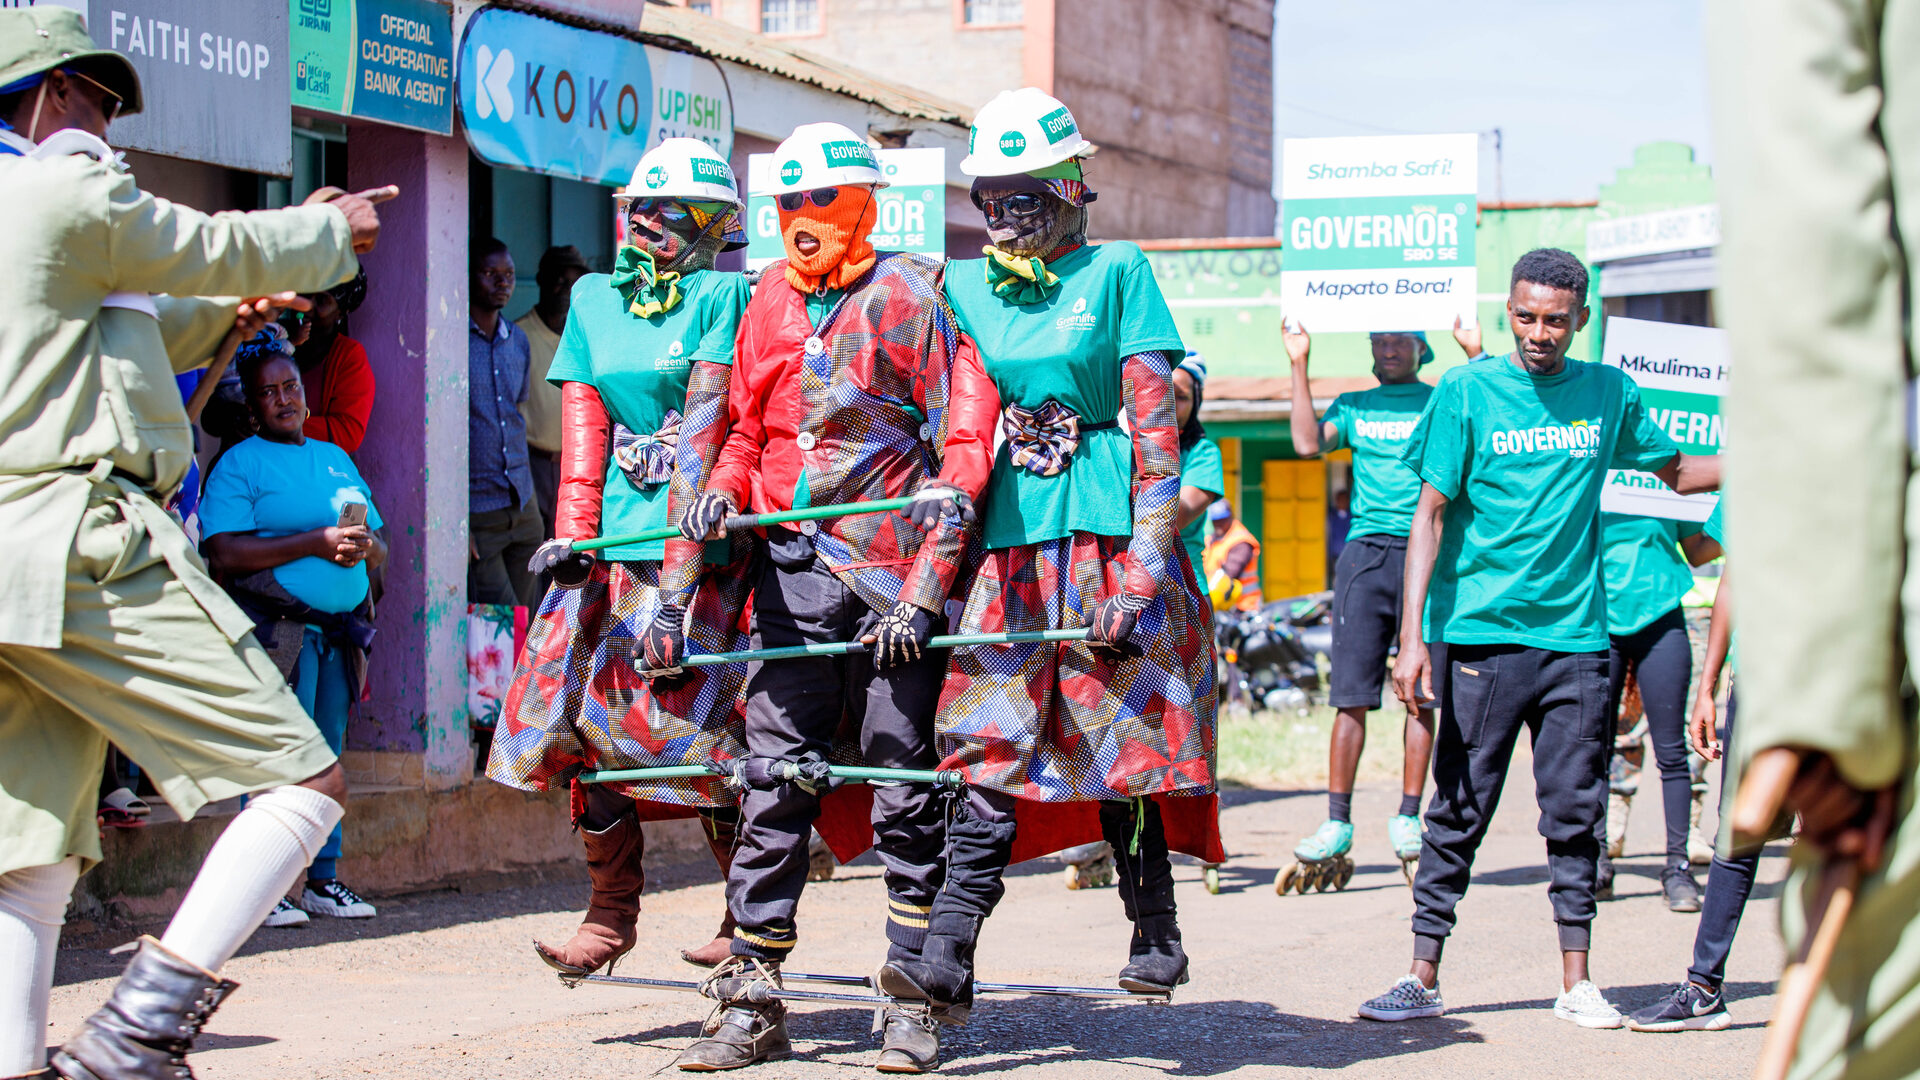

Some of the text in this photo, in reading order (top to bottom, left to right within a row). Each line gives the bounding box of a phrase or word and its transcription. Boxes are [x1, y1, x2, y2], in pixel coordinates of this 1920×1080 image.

[380, 13, 434, 46] OFFICIAL
[111, 10, 270, 81] FAITH SHOP
[362, 39, 449, 78] CO-OPERATIVE
[308, 76, 329, 95] Cash
[364, 69, 446, 106] BANK AGENT
[525, 61, 639, 136] KOKO
[658, 87, 721, 131] UPISHI
[1047, 112, 1072, 134] GOVE
[1001, 138, 1024, 149] 580 SE
[1307, 158, 1454, 180] Shamba Safi!
[904, 233, 924, 247] SE
[1290, 212, 1458, 250] GOVERNOR
[1437, 247, 1458, 261] SE
[1305, 277, 1453, 300] Mapato Bora!
[1056, 312, 1096, 326] Greenlife
[654, 356, 690, 367] Greenli
[1620, 354, 1711, 379] Mkulima
[1355, 418, 1416, 440] GOVERN
[1492, 424, 1601, 455] GOVERNOR
